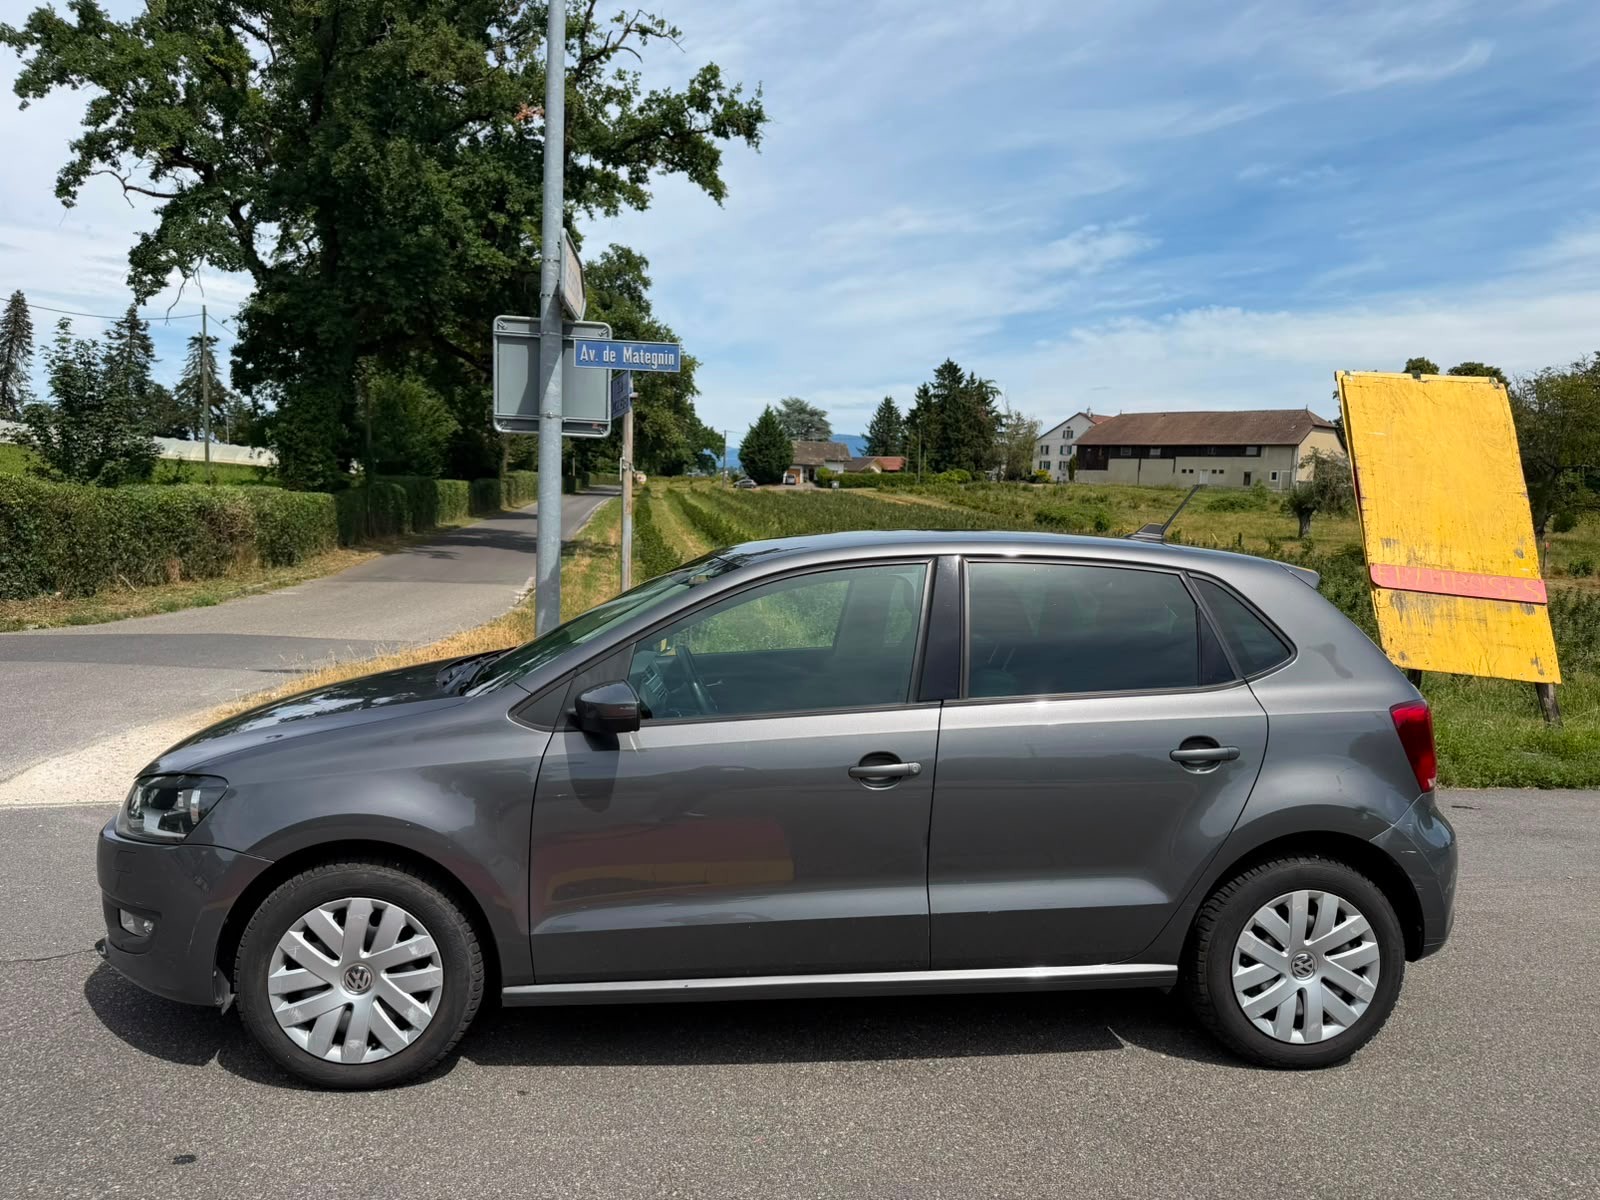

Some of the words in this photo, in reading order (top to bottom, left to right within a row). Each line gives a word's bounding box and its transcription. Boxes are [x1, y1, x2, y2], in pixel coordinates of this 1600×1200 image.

[580, 344, 599, 362] Av.
[603, 345, 616, 362] de
[623, 346, 675, 369] Mategnin
